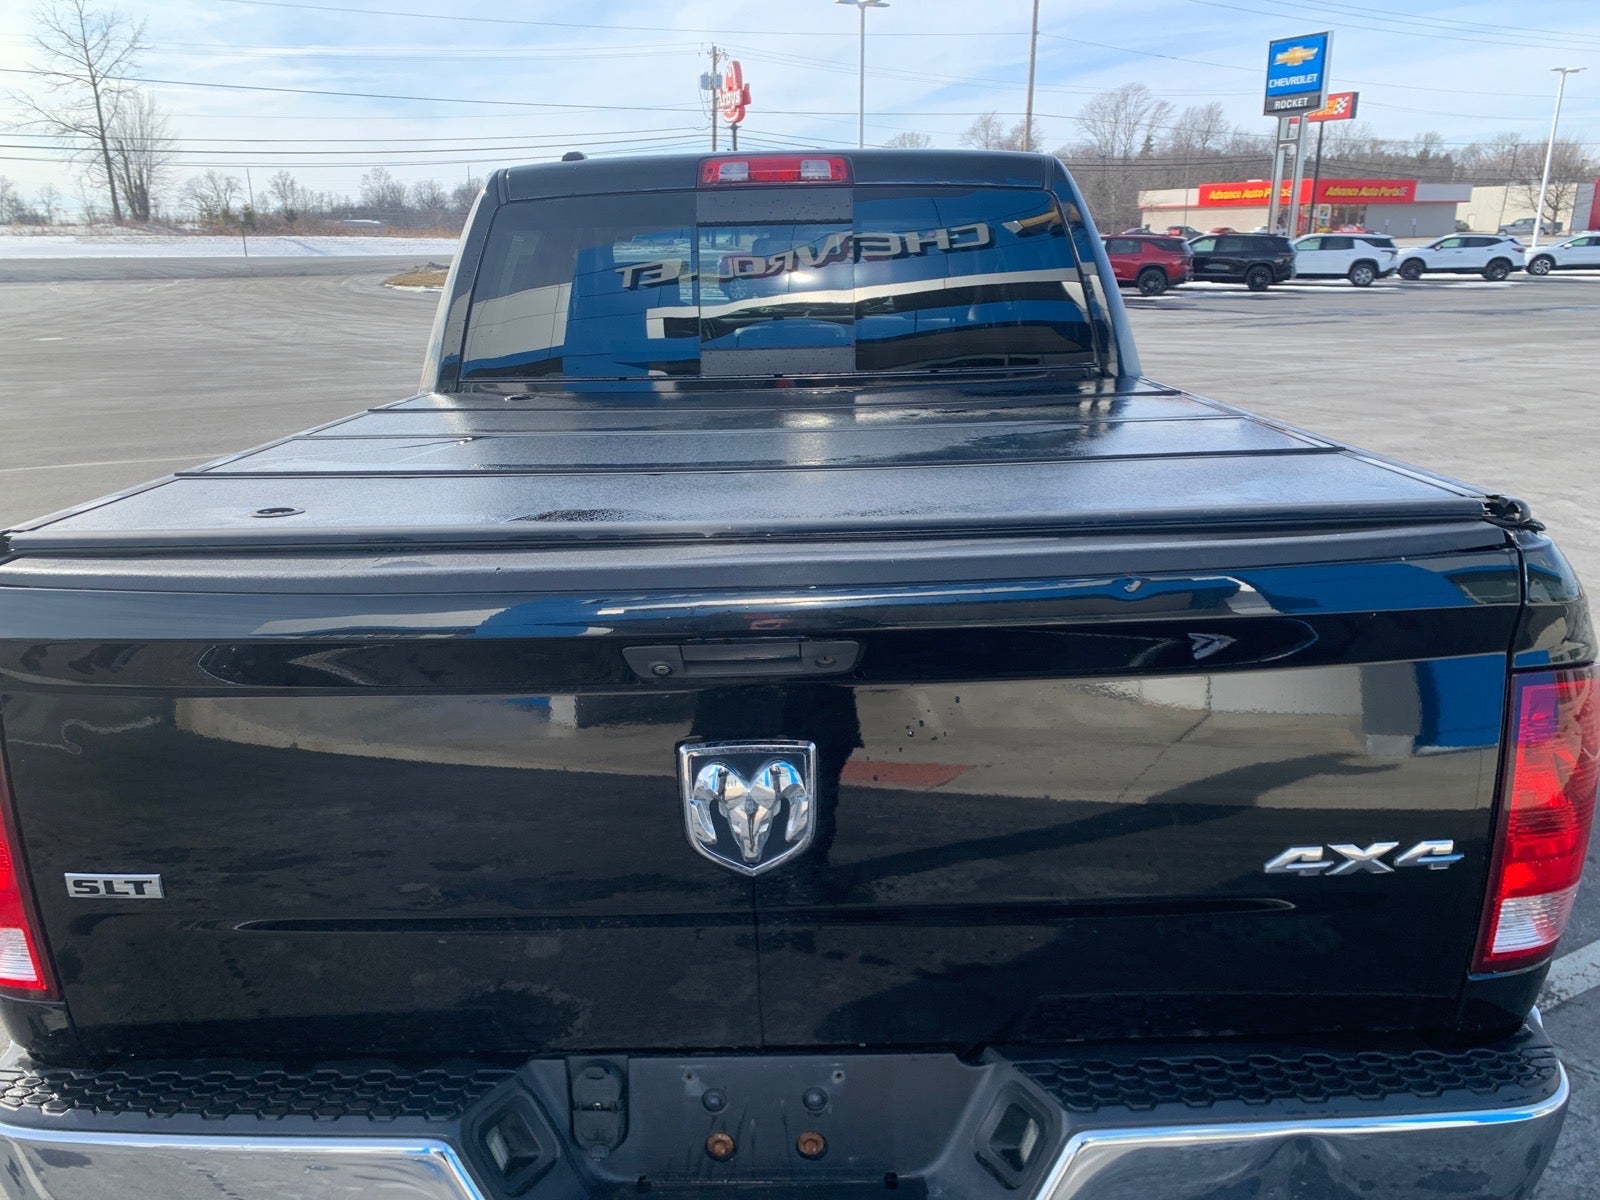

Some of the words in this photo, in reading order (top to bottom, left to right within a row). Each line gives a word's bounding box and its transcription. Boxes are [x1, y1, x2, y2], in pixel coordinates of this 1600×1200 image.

[1269, 73, 1319, 88] CHEVROLET
[1274, 97, 1309, 109] ROCKET
[1209, 190, 1242, 201] Advance
[1242, 188, 1264, 199] Auto
[1326, 186, 1359, 196] Advance
[1359, 186, 1379, 196] Auto
[1379, 186, 1401, 196] Parts
[73, 879, 151, 895] SLT
